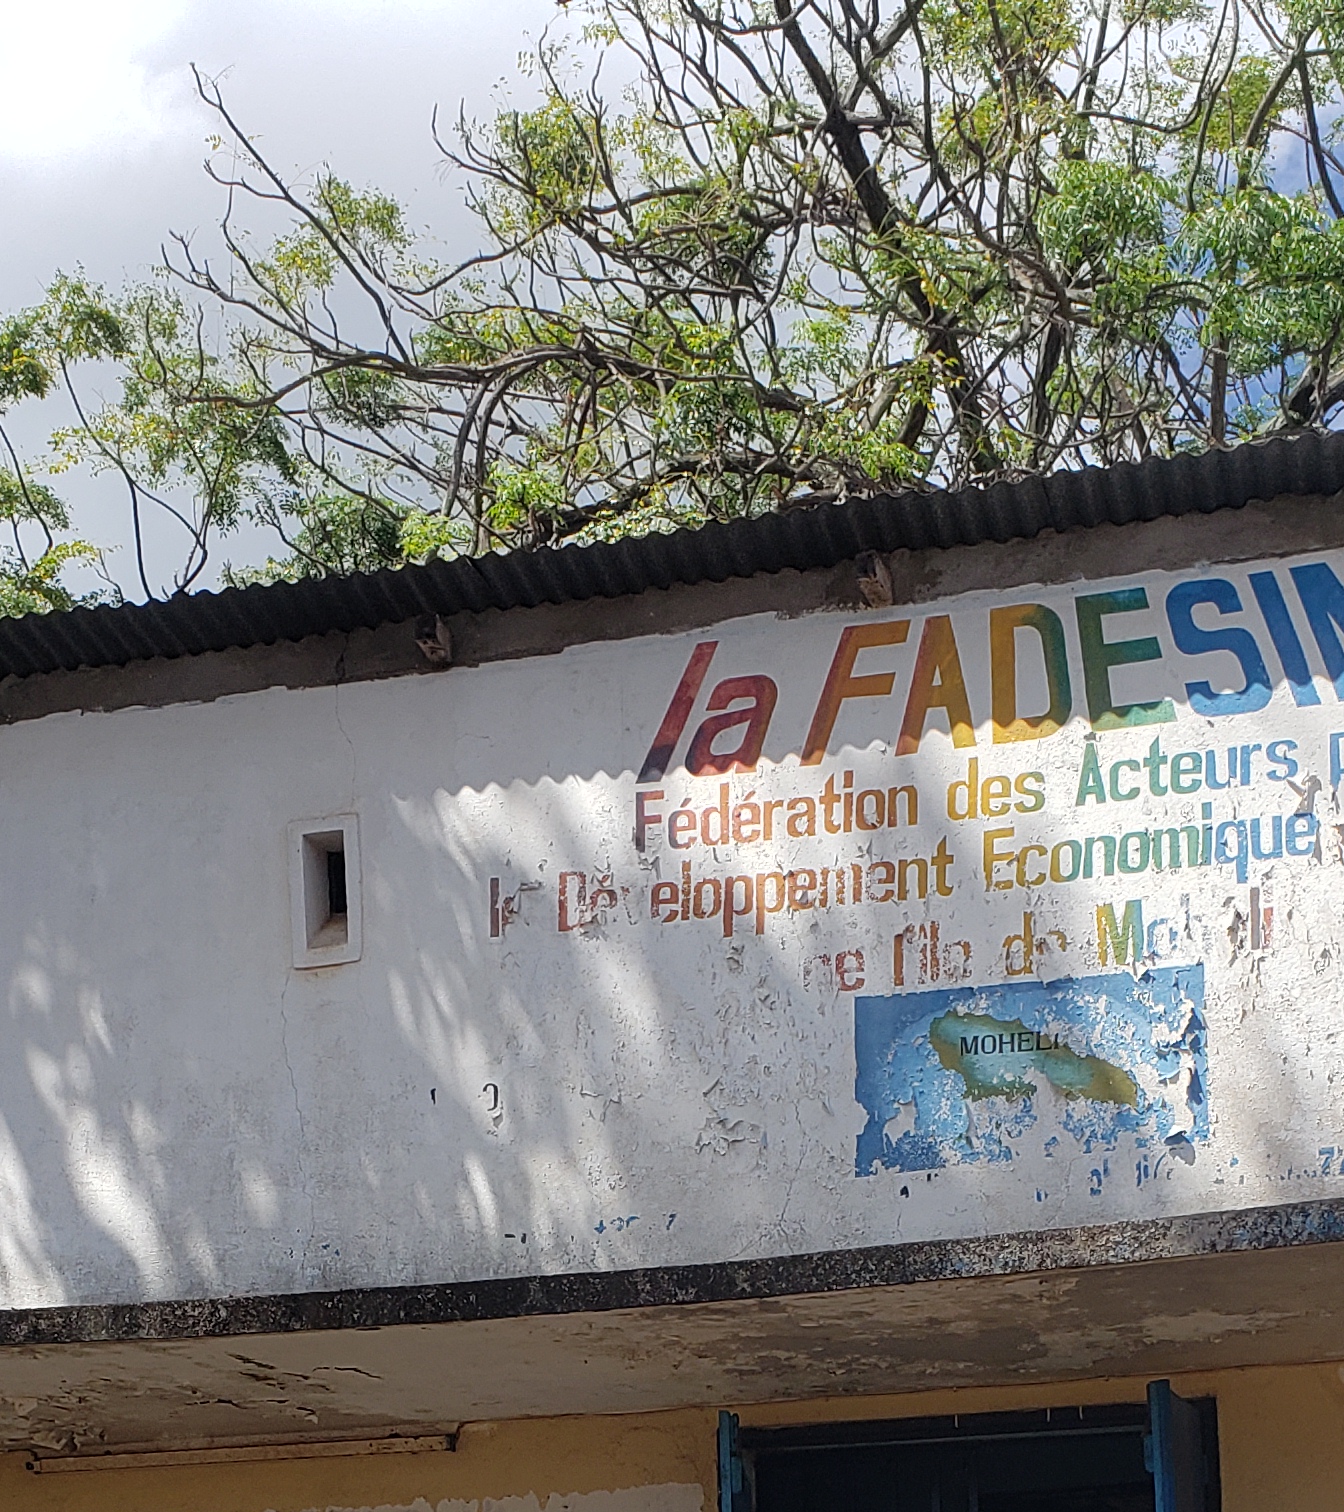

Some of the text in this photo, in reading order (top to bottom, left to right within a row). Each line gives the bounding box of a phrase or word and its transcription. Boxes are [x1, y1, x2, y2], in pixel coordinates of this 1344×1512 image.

[635, 640, 778, 784] la
[635, 769, 919, 853] Fédération
[947, 757, 1046, 822] des
[1074, 736, 1299, 807] Acteurs
[557, 836, 954, 938] Déeloppement
[982, 802, 1318, 892] Economique
[959, 1030, 1060, 1056] MOHELI
